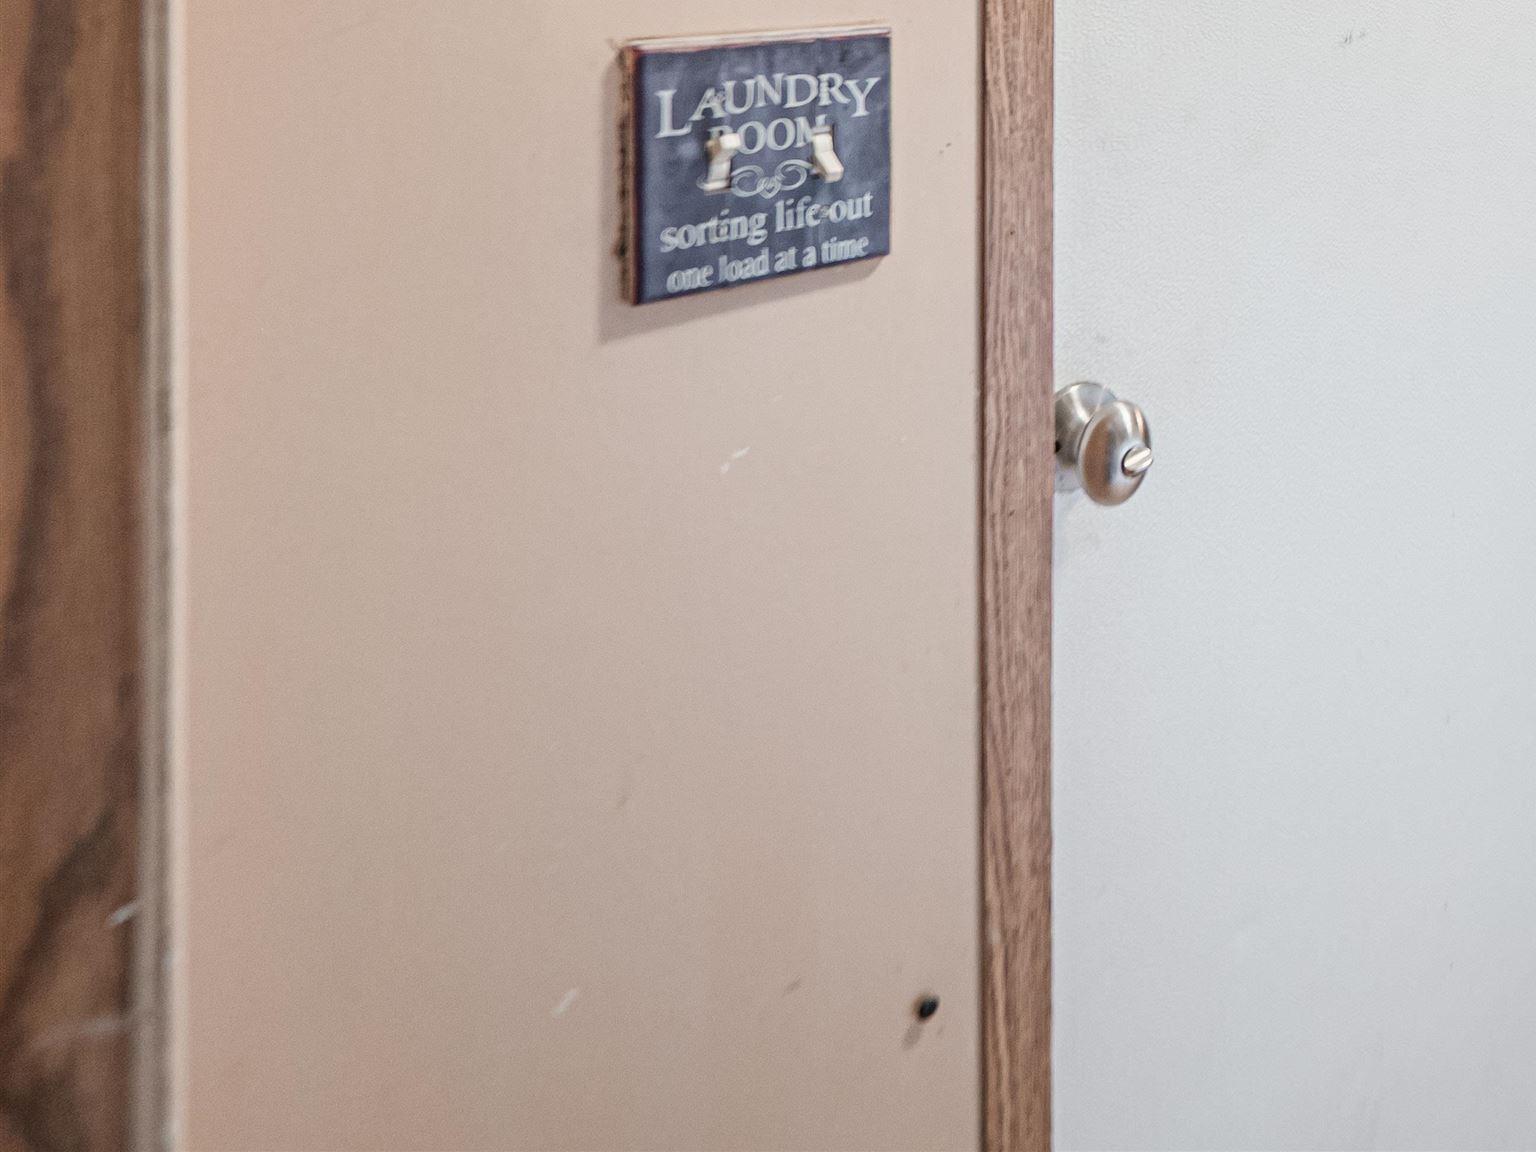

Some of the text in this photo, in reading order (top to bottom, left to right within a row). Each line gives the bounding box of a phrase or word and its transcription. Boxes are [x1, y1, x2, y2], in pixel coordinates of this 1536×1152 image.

[655, 72, 881, 139] LAUNDRY
[659, 209, 768, 253] sorting
[829, 191, 873, 221] out
[666, 236, 869, 294] one load at a time
